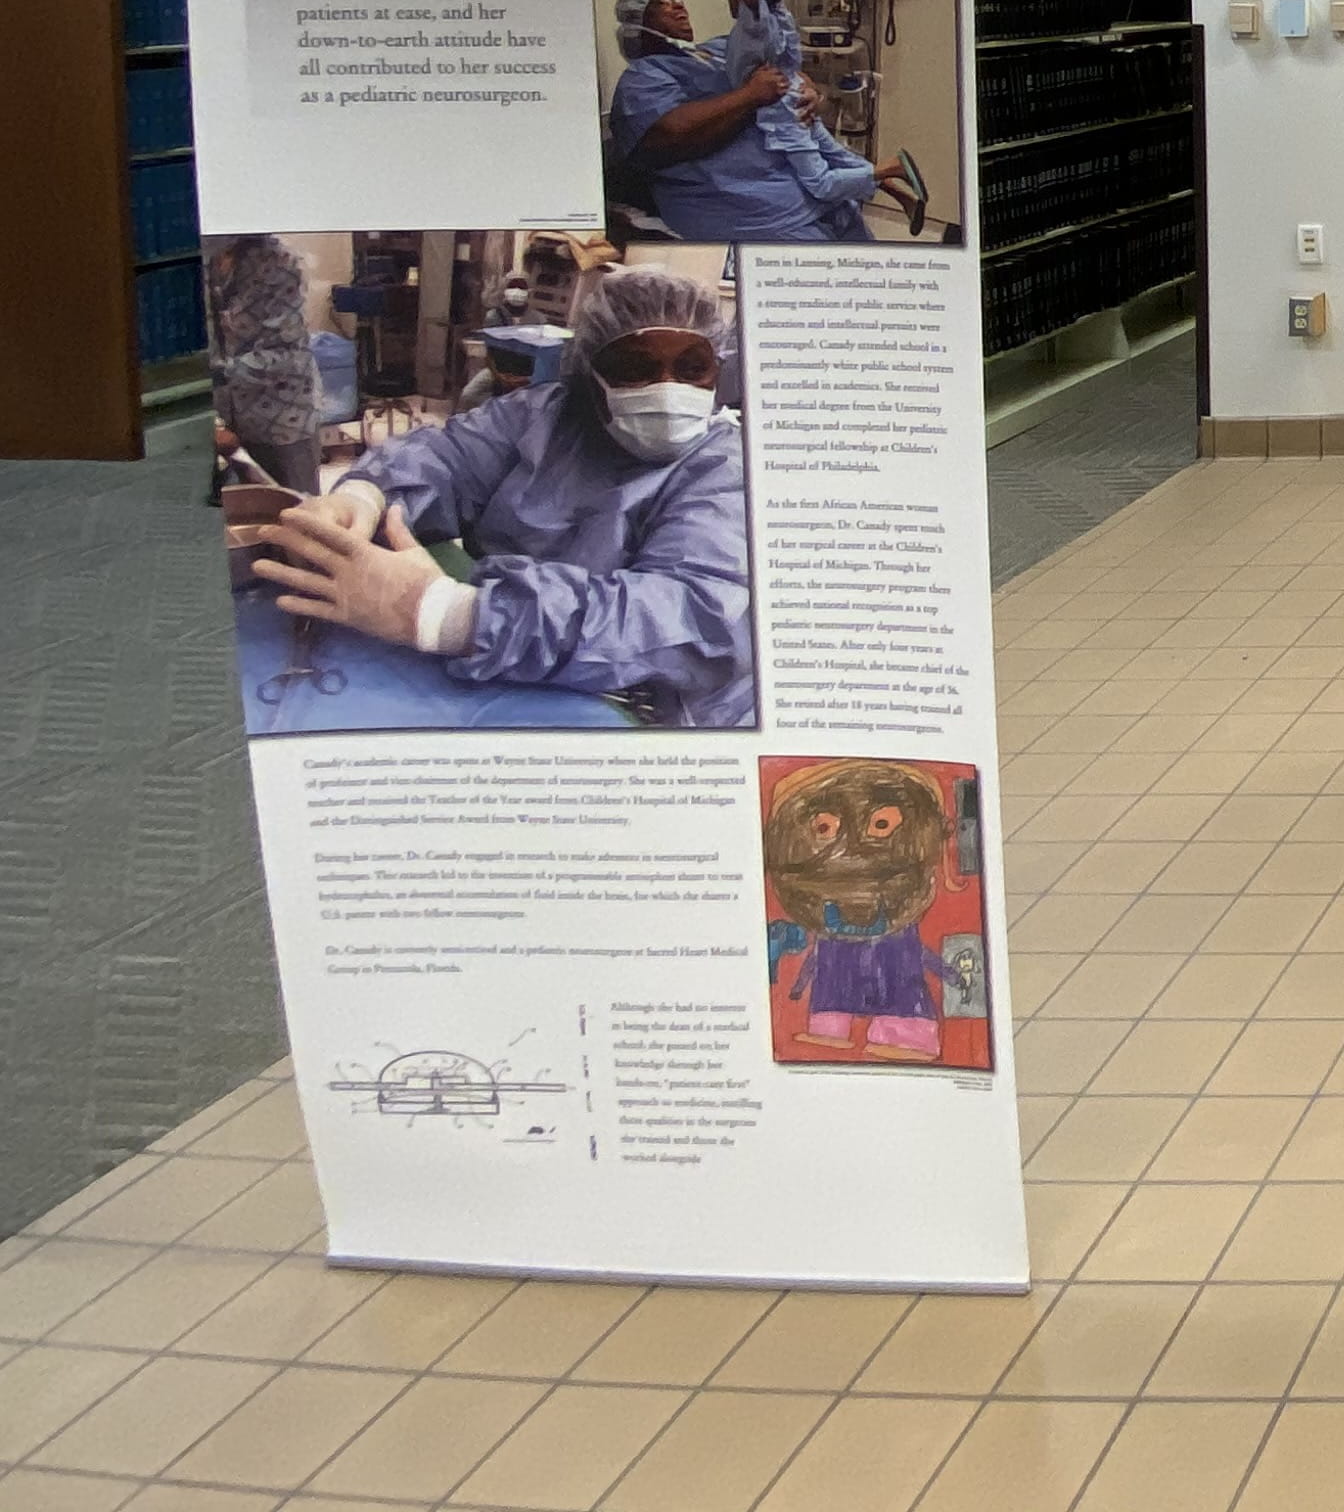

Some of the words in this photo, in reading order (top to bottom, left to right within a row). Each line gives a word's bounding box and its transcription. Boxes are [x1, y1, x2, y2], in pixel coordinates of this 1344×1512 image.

[297, 30, 430, 48] down-to-earth
[434, 30, 502, 47] attitude
[506, 30, 546, 47] have
[299, 57, 321, 75] all
[325, 57, 432, 75] contributed
[436, 63, 456, 75] to
[459, 57, 490, 75] her
[494, 62, 556, 75] success
[300, 91, 319, 103] as
[324, 91, 334, 103] a
[339, 85, 417, 106] pediatric
[422, 90, 547, 106] neurosurgeon.
